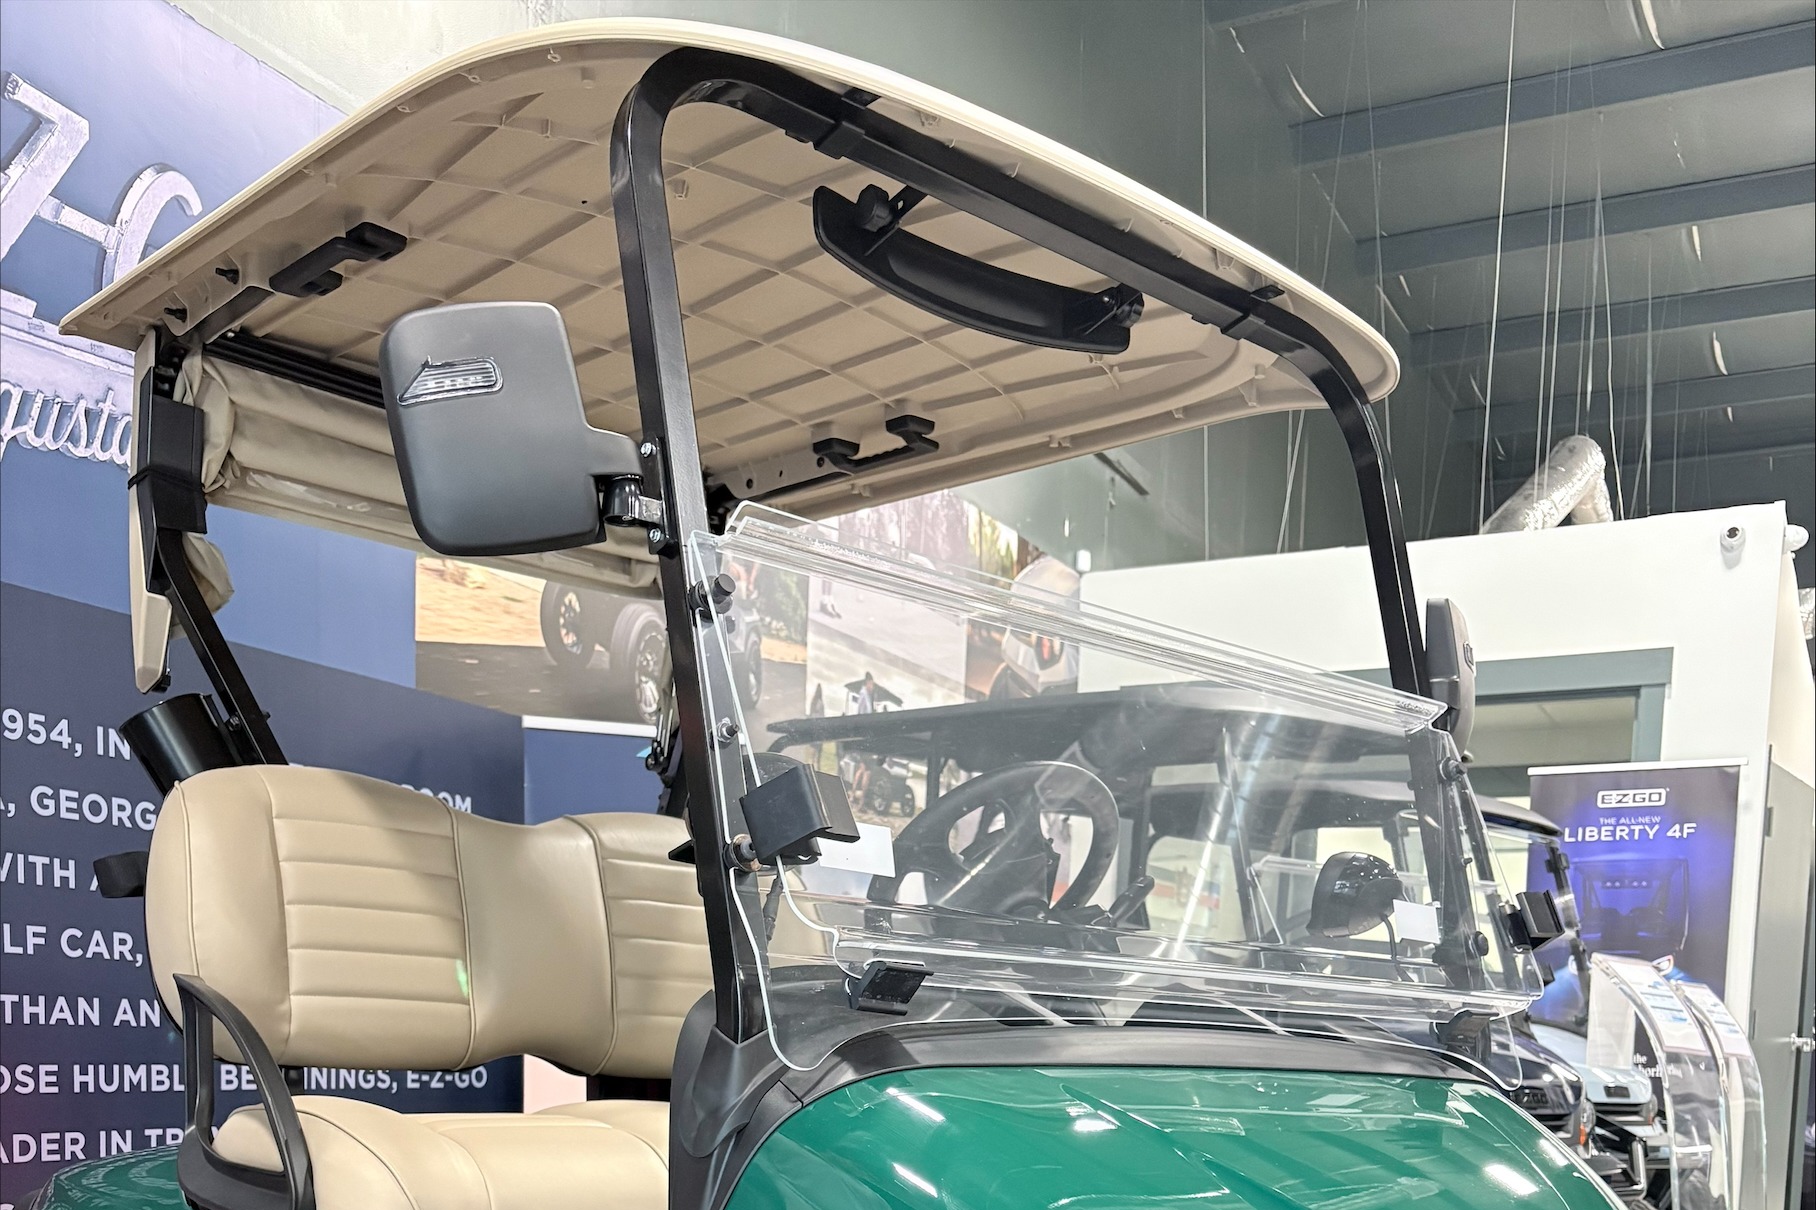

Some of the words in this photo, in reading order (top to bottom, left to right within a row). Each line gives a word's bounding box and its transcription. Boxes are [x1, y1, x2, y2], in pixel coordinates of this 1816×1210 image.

[2, 708, 83, 758] 954,
[1564, 824, 1660, 842] LIBERTY
[1666, 822, 1697, 839] 4F
[1600, 817, 1617, 826] THE
[1620, 815, 1661, 825] ALL-NEW
[60, 927, 143, 967] CAR,
[0, 993, 100, 1026] THAN
[73, 1064, 186, 1093] HUMBL
